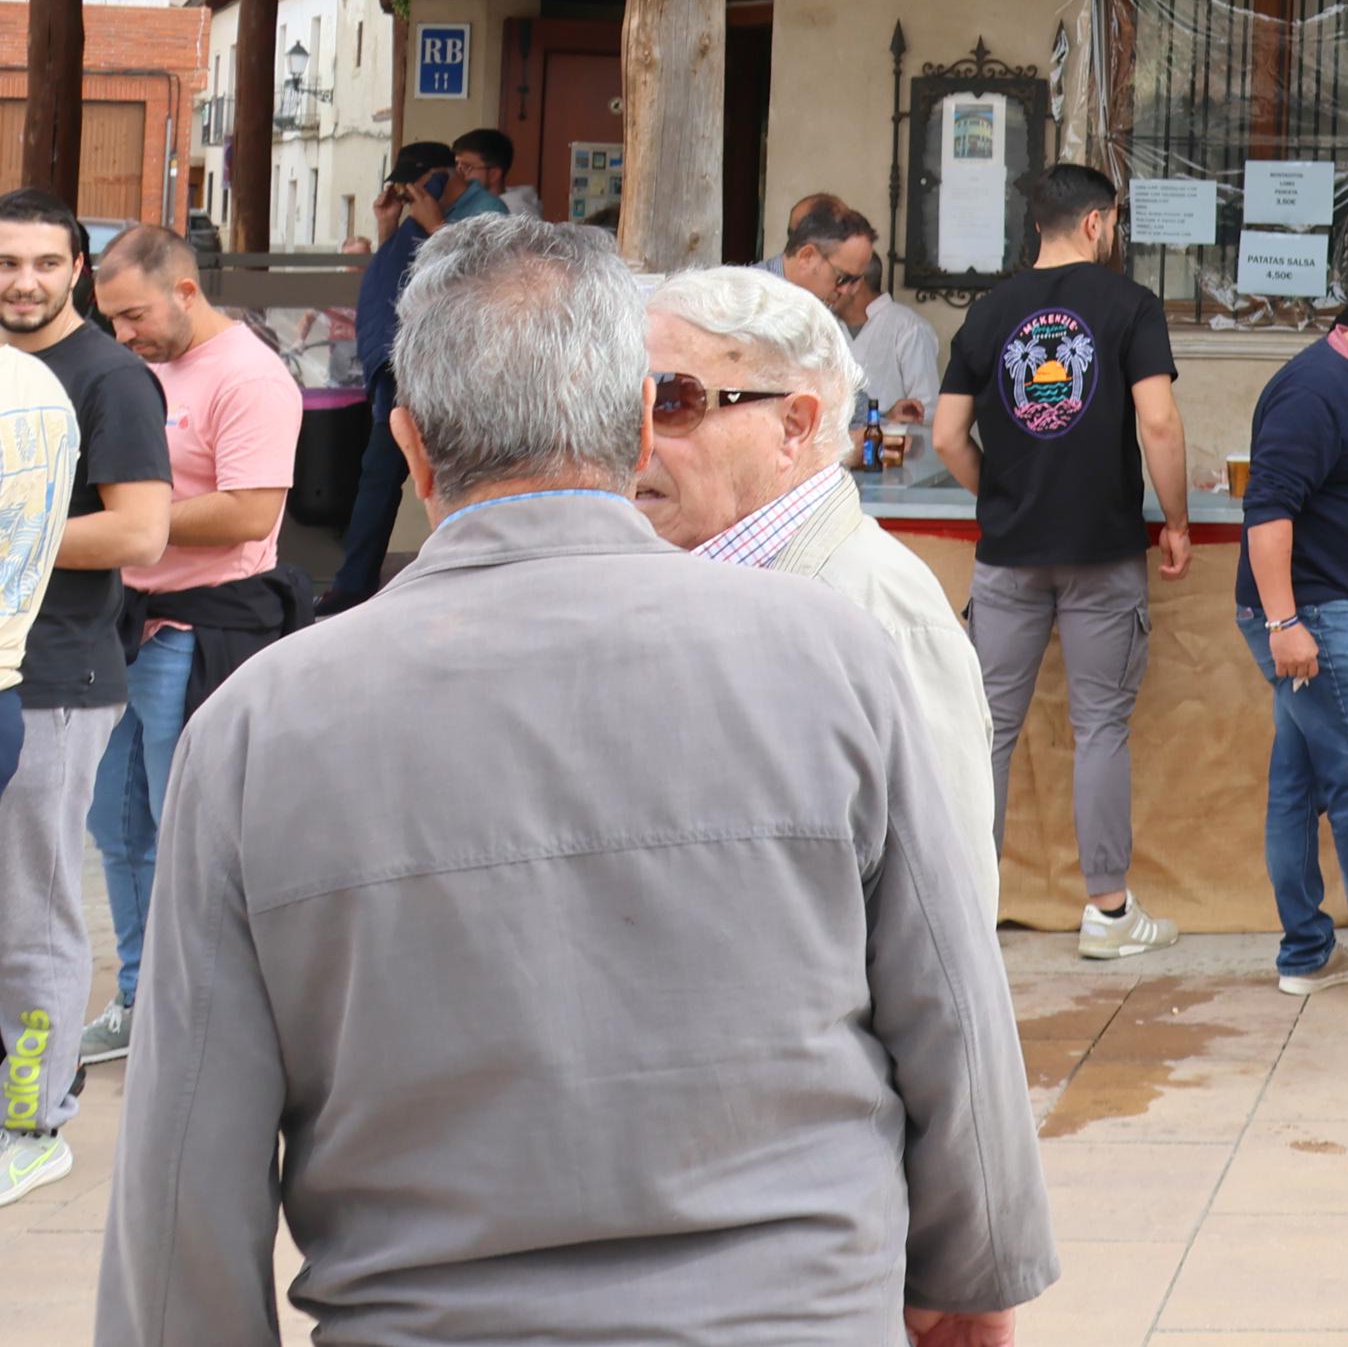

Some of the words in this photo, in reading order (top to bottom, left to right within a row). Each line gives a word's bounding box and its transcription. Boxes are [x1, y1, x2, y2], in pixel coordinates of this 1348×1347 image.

[423, 37, 463, 64] RB
[1247, 255, 1285, 265] PATATAS
[1287, 257, 1315, 267] SALSA
[1266, 270, 1294, 280] 4,50€
